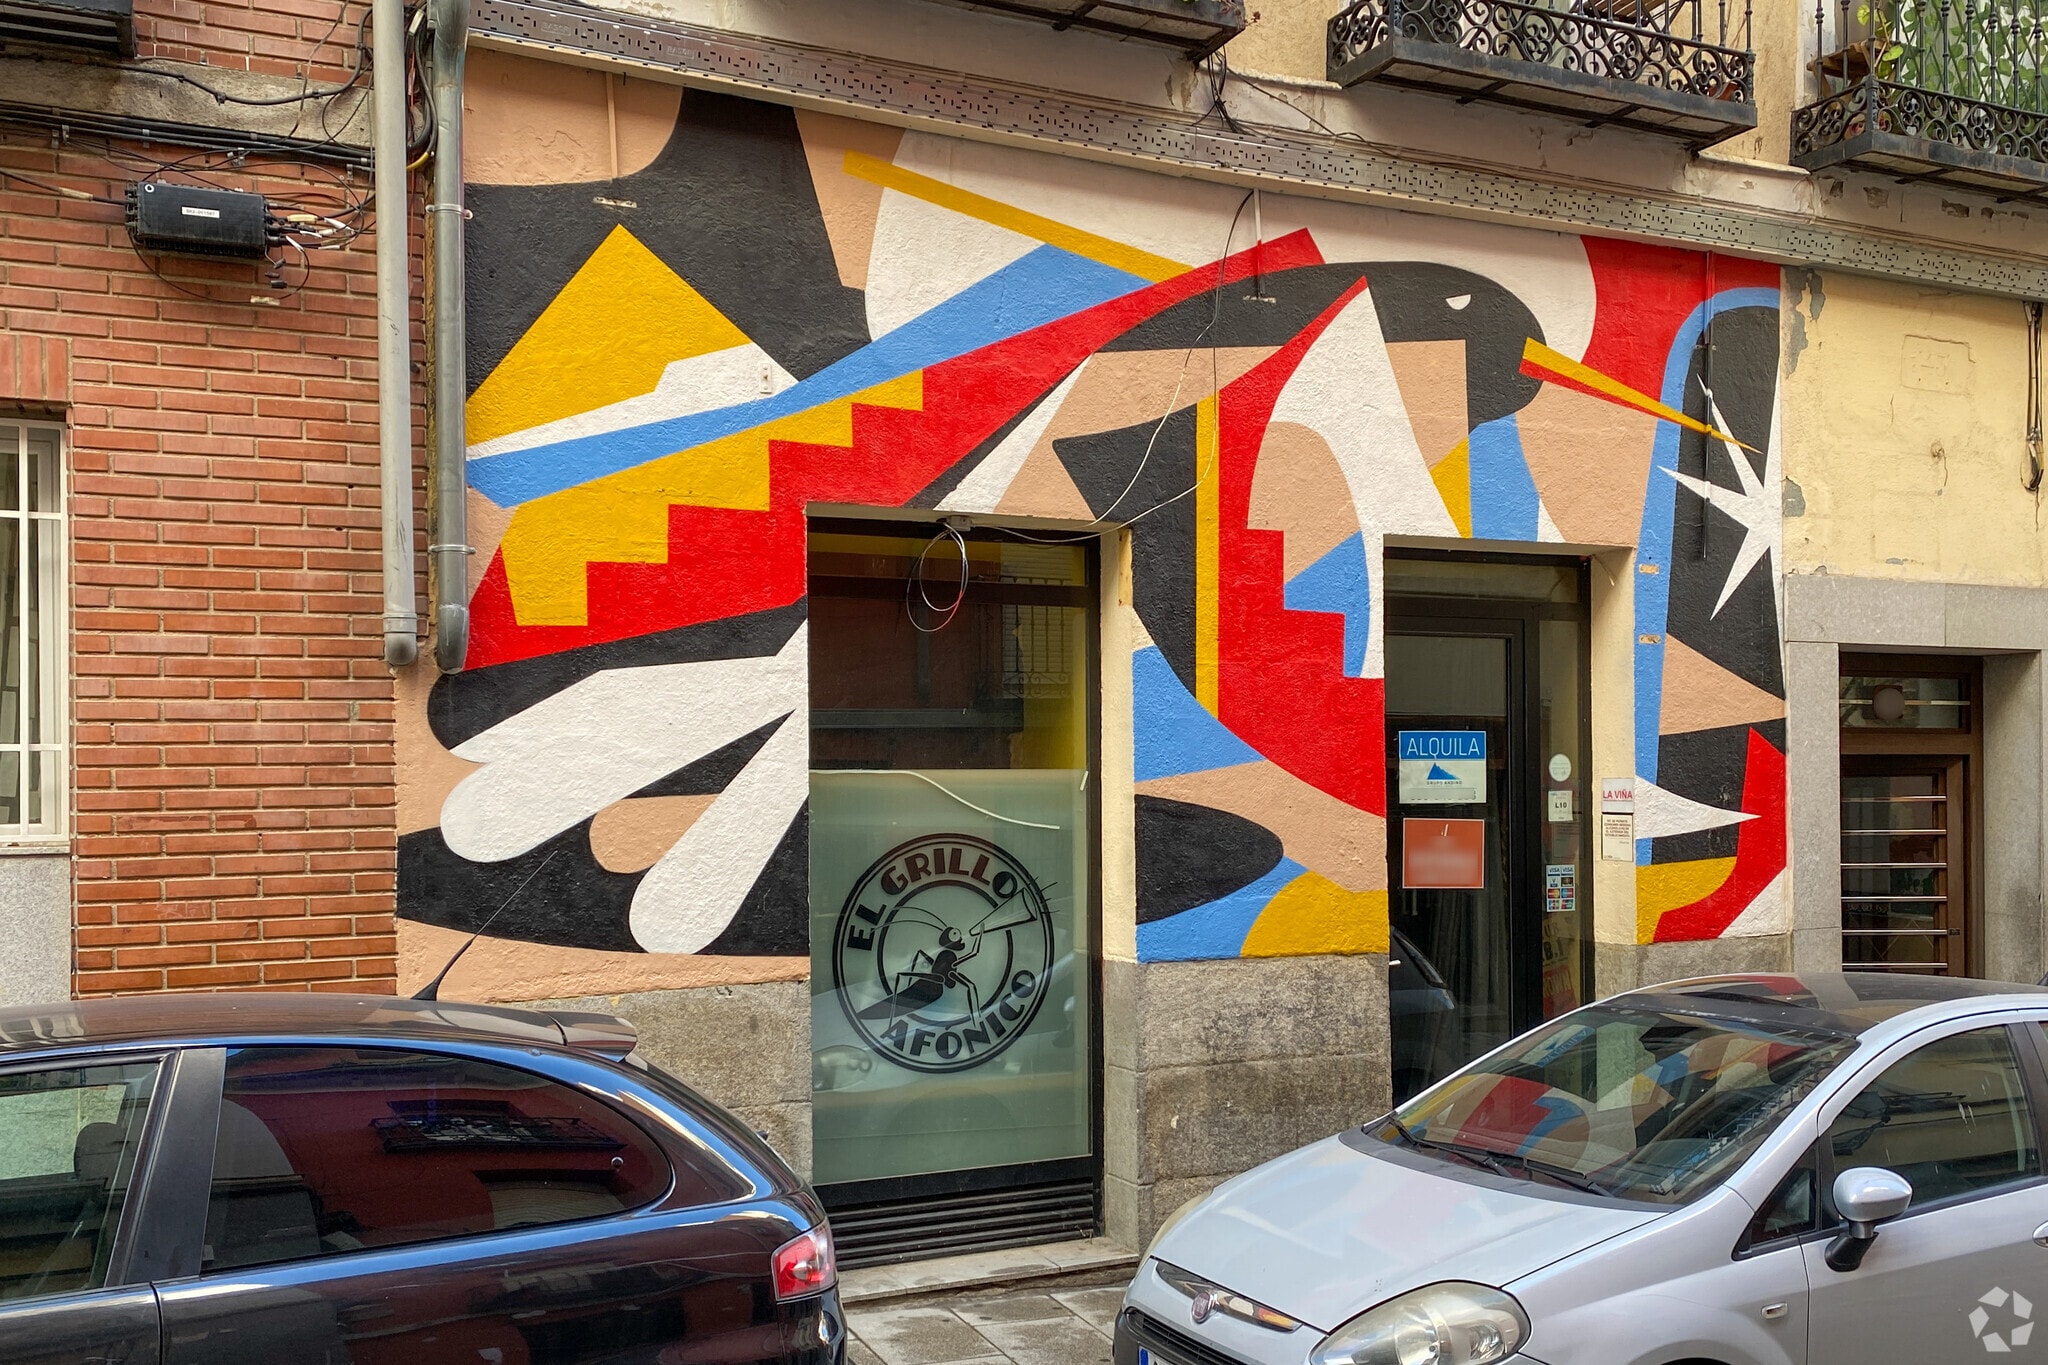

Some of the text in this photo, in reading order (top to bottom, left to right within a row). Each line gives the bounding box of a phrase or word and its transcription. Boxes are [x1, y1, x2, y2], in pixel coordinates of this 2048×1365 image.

[1406, 737, 1480, 760] ALQUILA
[1555, 801, 1567, 809] L10
[1602, 788, 1633, 799] LA VIÑA
[847, 848, 1018, 951] EL GRILLO
[880, 970, 1036, 1060] AFÓNICO
